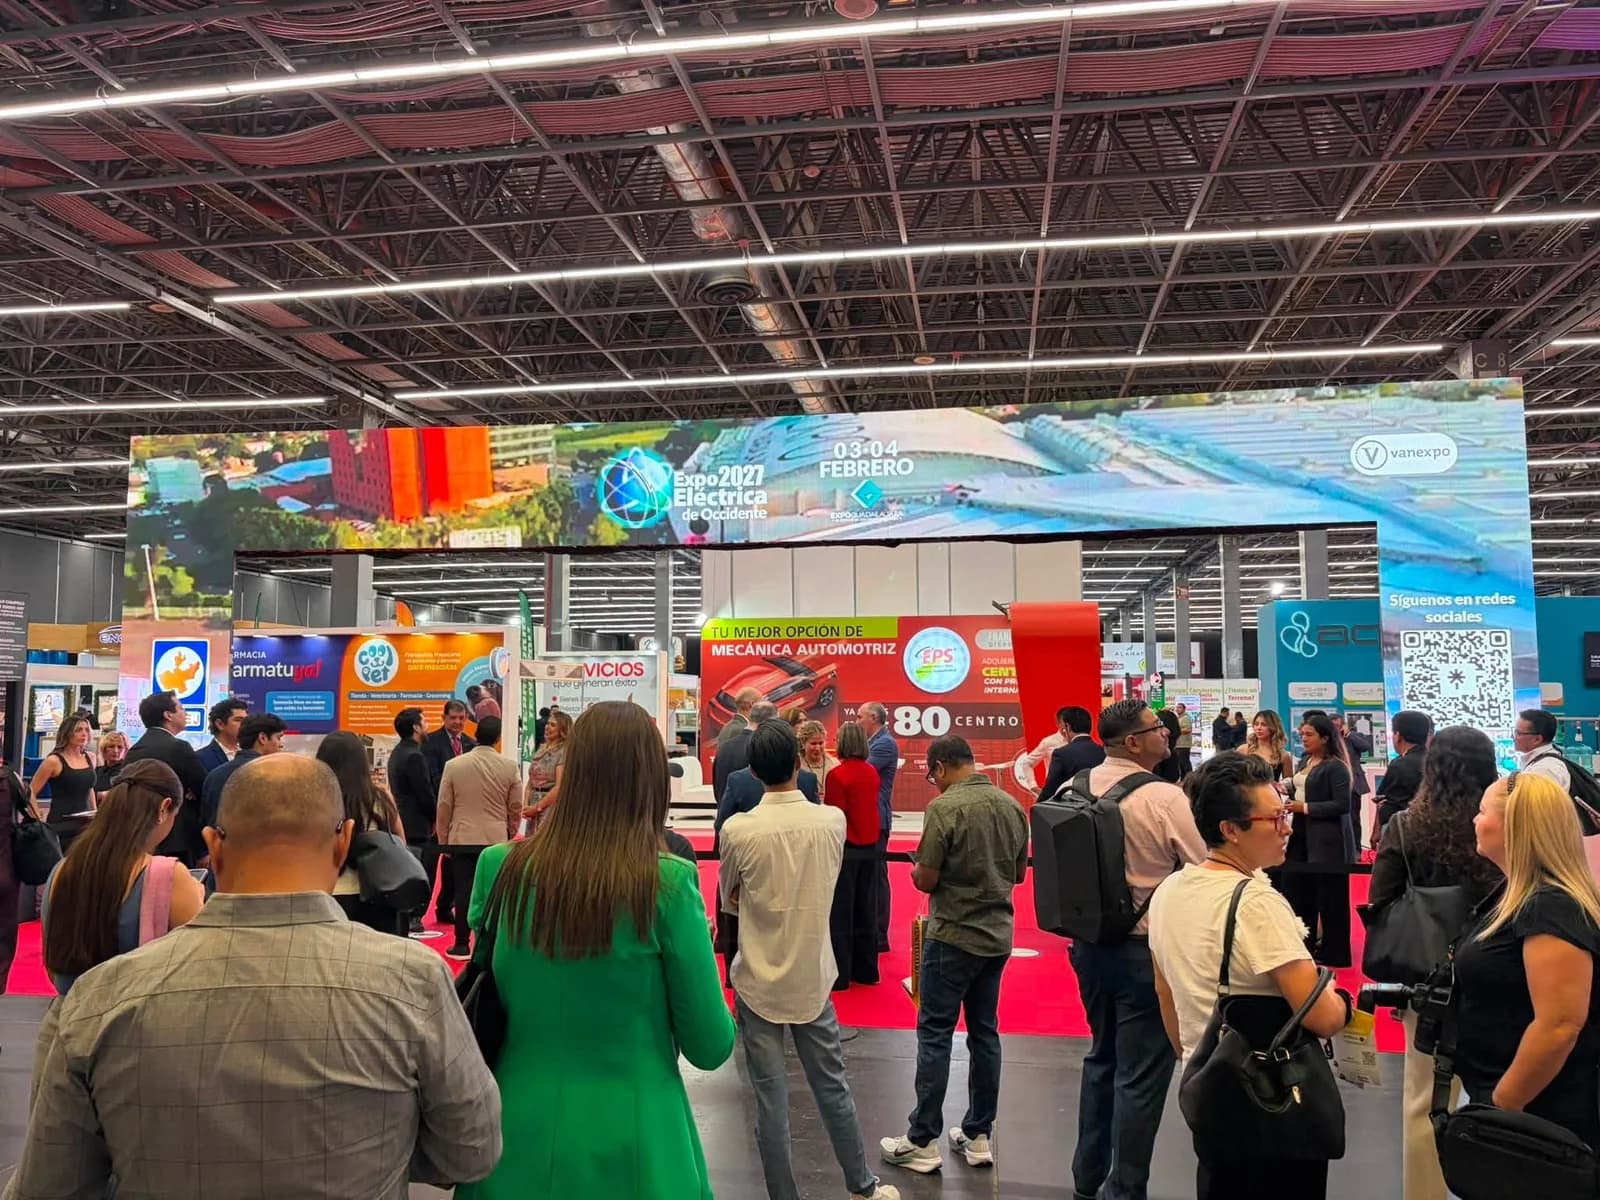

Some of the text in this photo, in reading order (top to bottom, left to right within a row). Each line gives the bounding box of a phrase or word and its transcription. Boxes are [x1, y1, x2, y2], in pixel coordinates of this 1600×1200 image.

[1390, 447, 1451, 461] vanexpo
[819, 458, 914, 479] FEBRERO
[673, 487, 767, 507] Eléctrica
[682, 507, 768, 521] de Occidente
[1389, 593, 1517, 609] Síguenos en redes
[1425, 611, 1483, 623] sociales
[711, 624, 863, 638] TU MEJOR OPCIÓN DE
[232, 651, 267, 659] RMACIA
[711, 641, 897, 657] MECÁNICA AUTOMOTRIZ
[922, 648, 954, 665] EPS
[893, 705, 951, 737] 80
